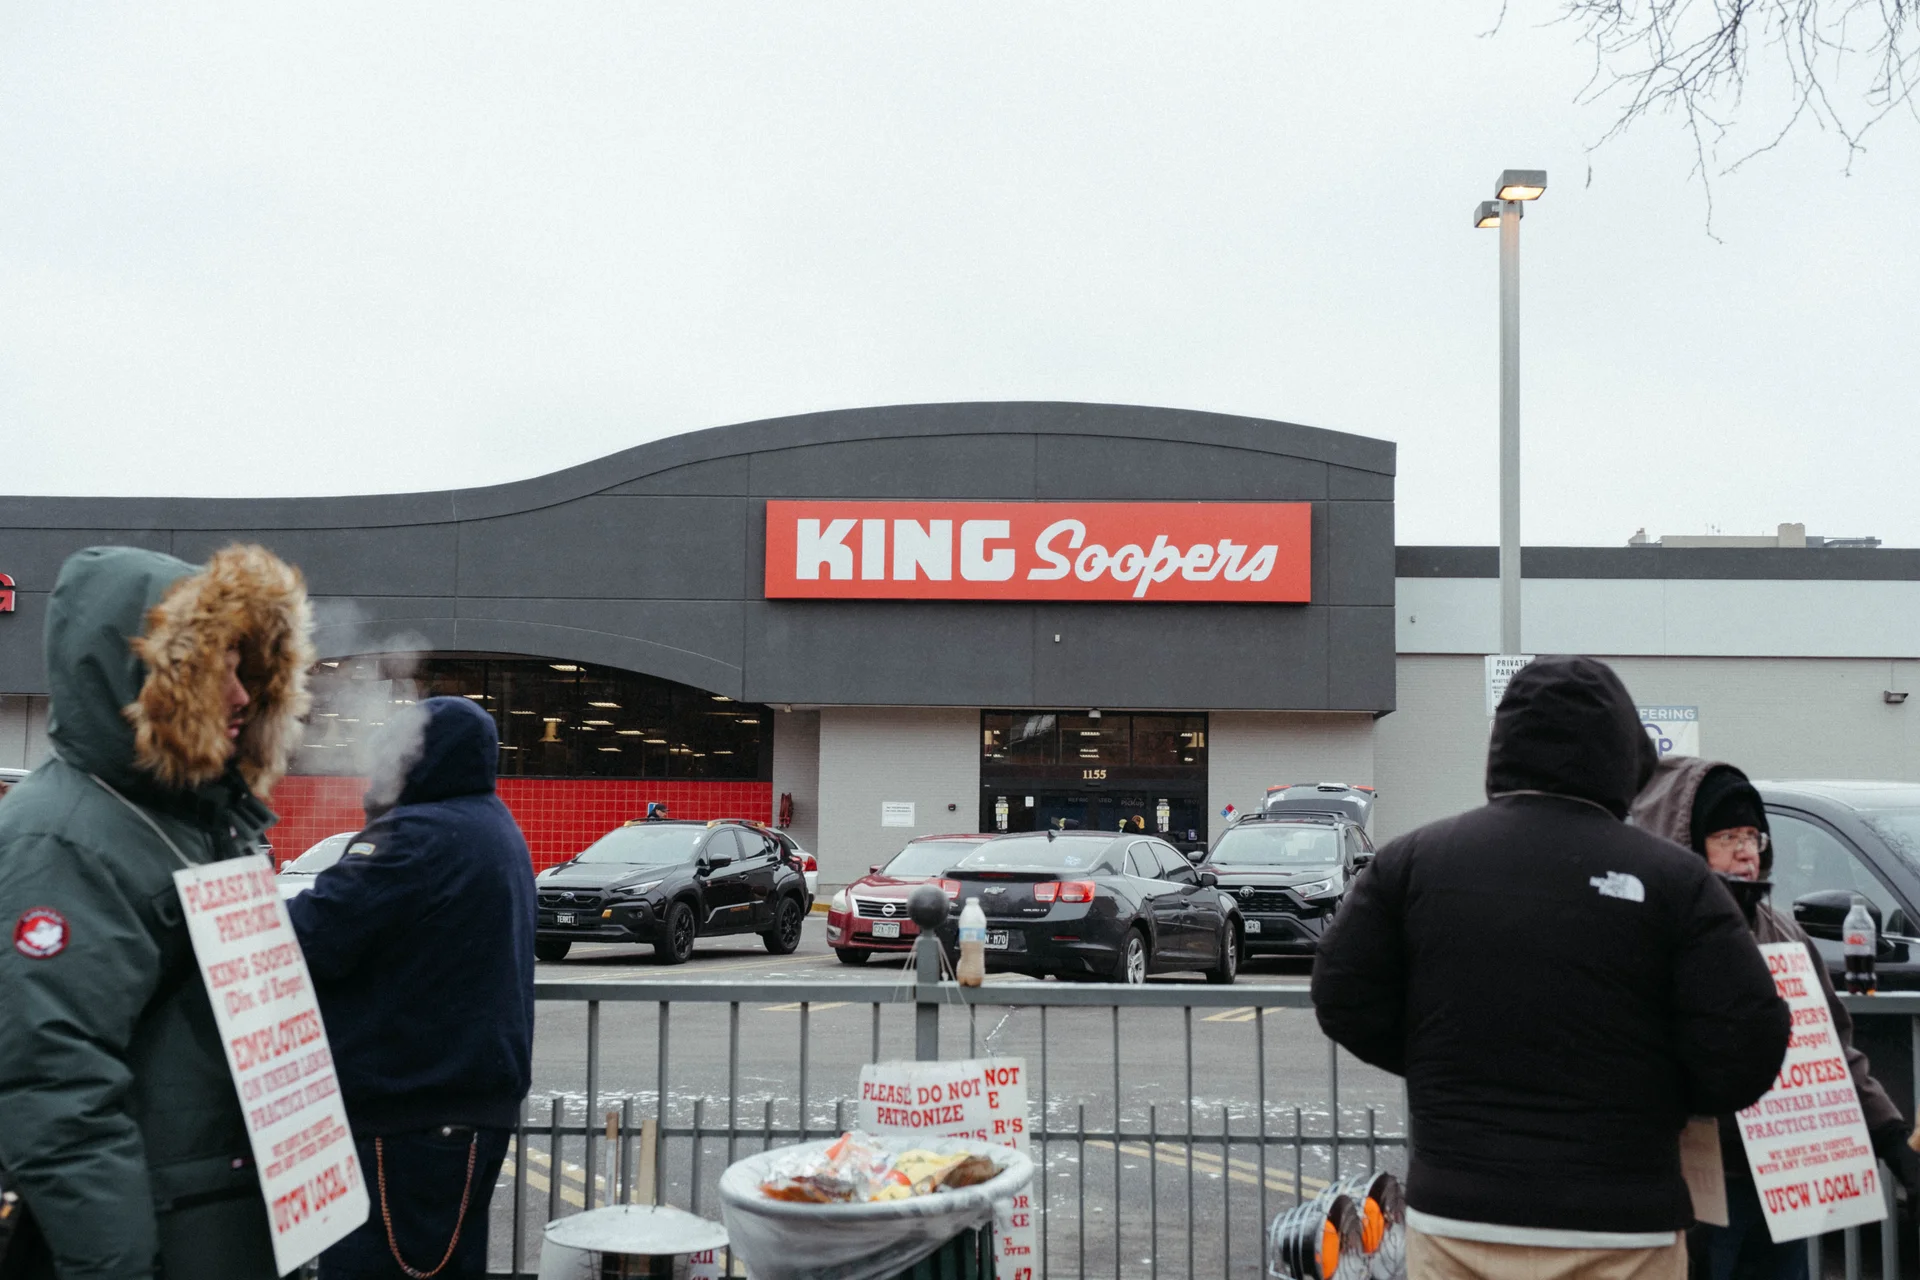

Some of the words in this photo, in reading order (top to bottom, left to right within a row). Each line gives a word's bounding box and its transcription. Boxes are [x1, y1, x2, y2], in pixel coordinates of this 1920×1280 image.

[796, 518, 1016, 581] KING
[1027, 518, 1279, 598] Soopers
[1495, 668, 1519, 676] PARK
[1496, 659, 1528, 667] PRIVATE
[1639, 709, 1696, 720] FERING
[1082, 769, 1107, 779] 1155
[1767, 953, 1788, 975] DO
[984, 1067, 1020, 1087] NOT
[1776, 1057, 1847, 1090] LOYEES
[863, 1082, 912, 1105] PLEASE
[917, 1084, 943, 1106] DO
[947, 1078, 982, 1100] NOT
[1764, 1093, 1816, 1116] UNFAIR
[1816, 1088, 1857, 1107] LABOR
[877, 1103, 965, 1128] PATRONIZE
[1745, 1114, 1818, 1141] PRACTICE
[1818, 1108, 1862, 1129] STRIKE
[1763, 1182, 1812, 1215] UFCW
[1813, 1172, 1861, 1205] LOCAL
[1862, 1168, 1876, 1195] #7
